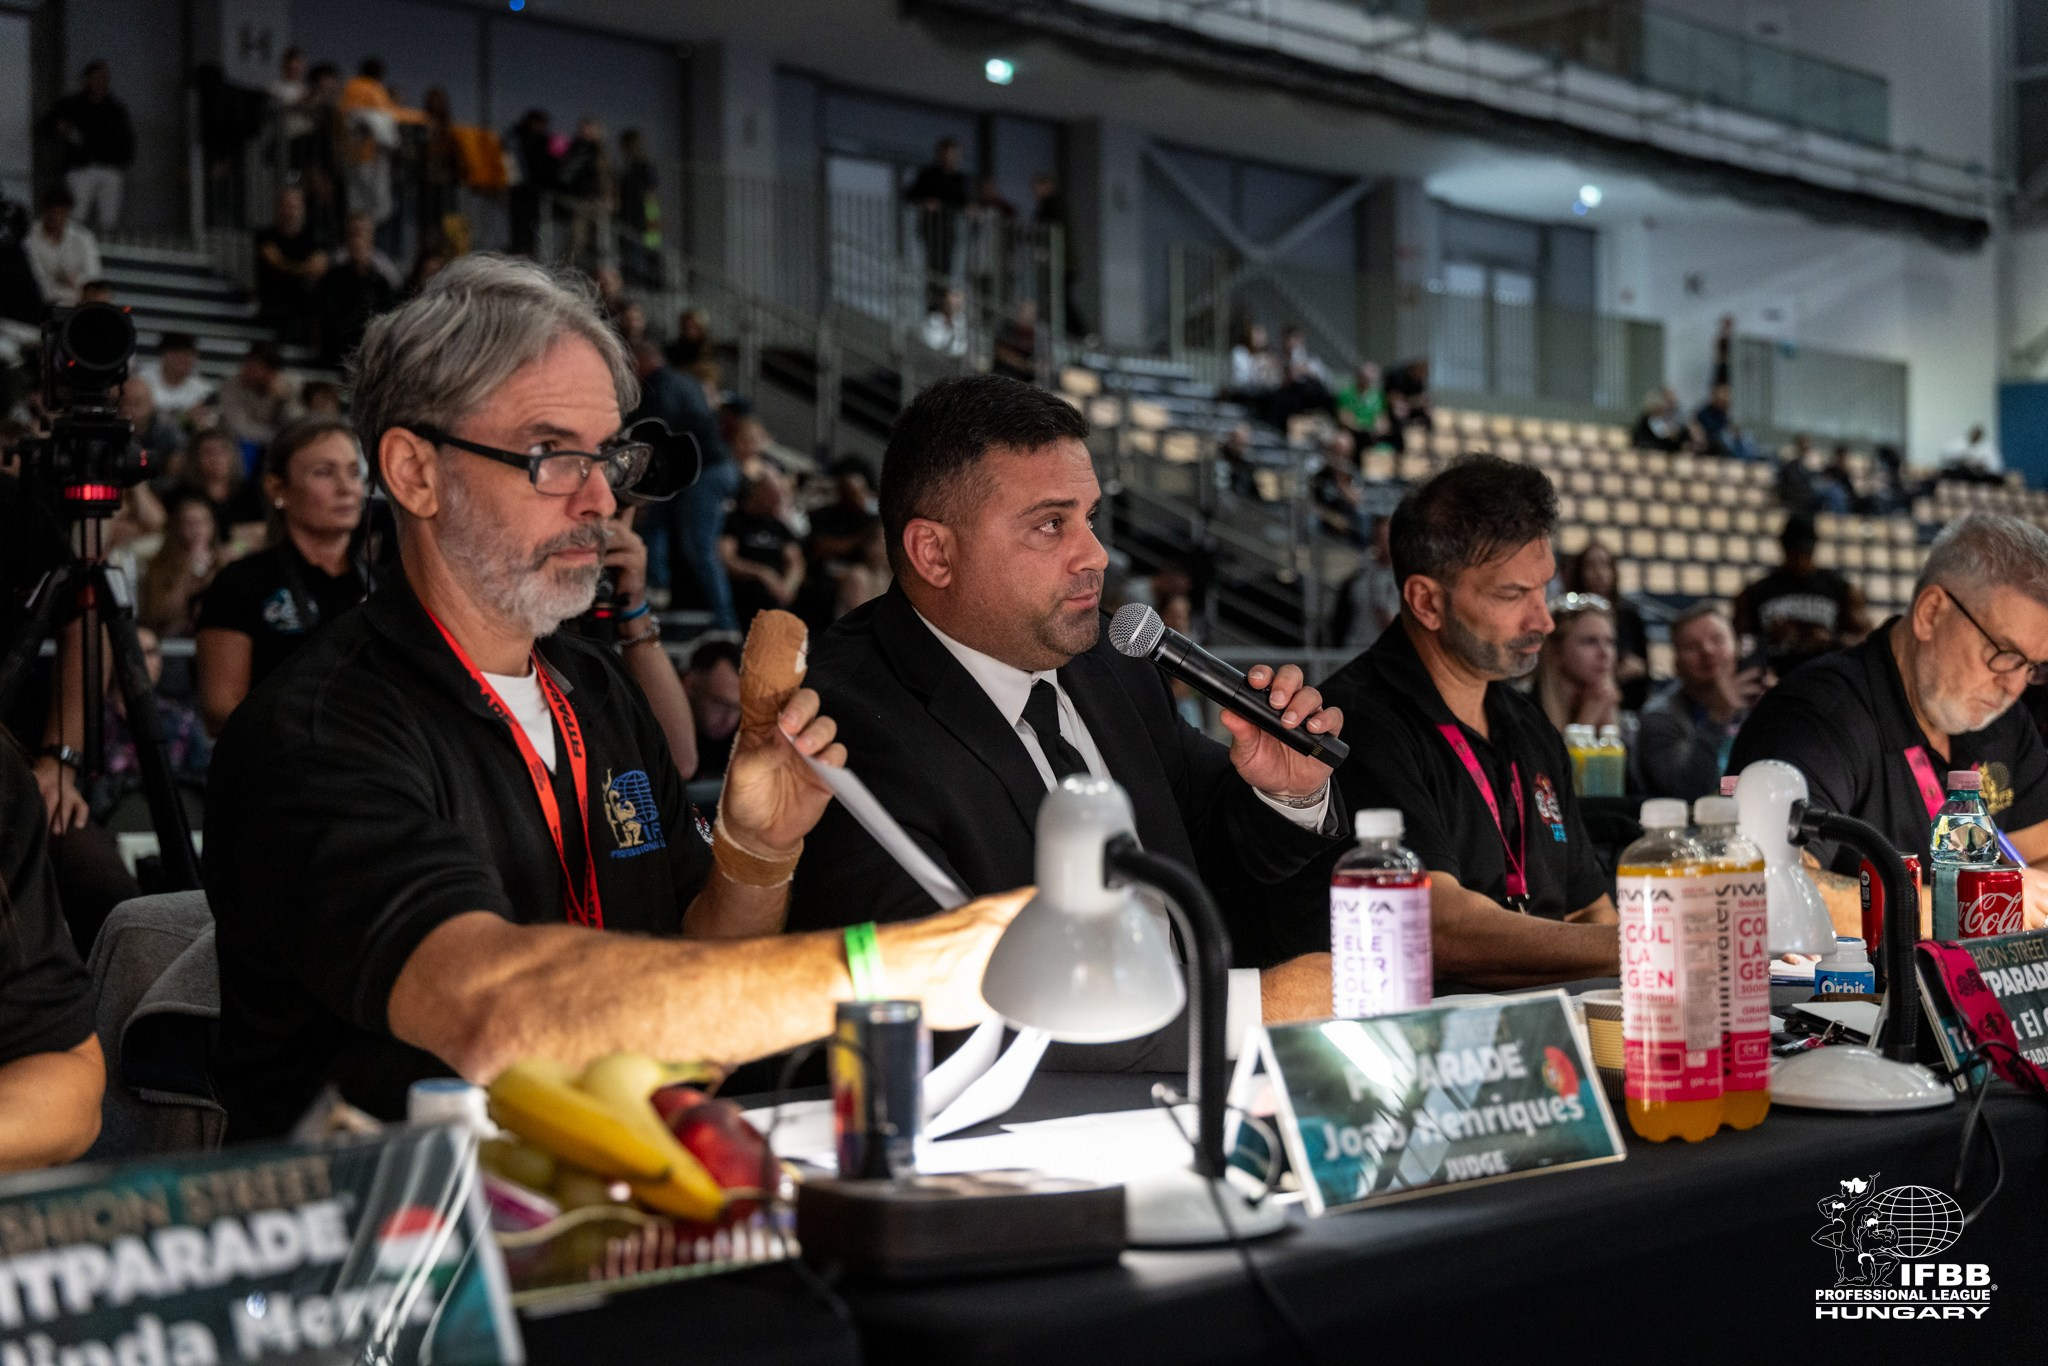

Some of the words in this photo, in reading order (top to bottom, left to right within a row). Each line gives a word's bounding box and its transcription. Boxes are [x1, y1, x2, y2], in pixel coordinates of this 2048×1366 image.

[1626, 925, 1671, 943] COL
[1739, 941, 1762, 958] LA
[2007, 938, 2047, 963] STREET
[1628, 970, 1674, 988] GEN
[1821, 978, 1865, 994] Orbit
[1412, 1093, 1585, 1146] Henriques
[1445, 1150, 1510, 1182] JUDGE
